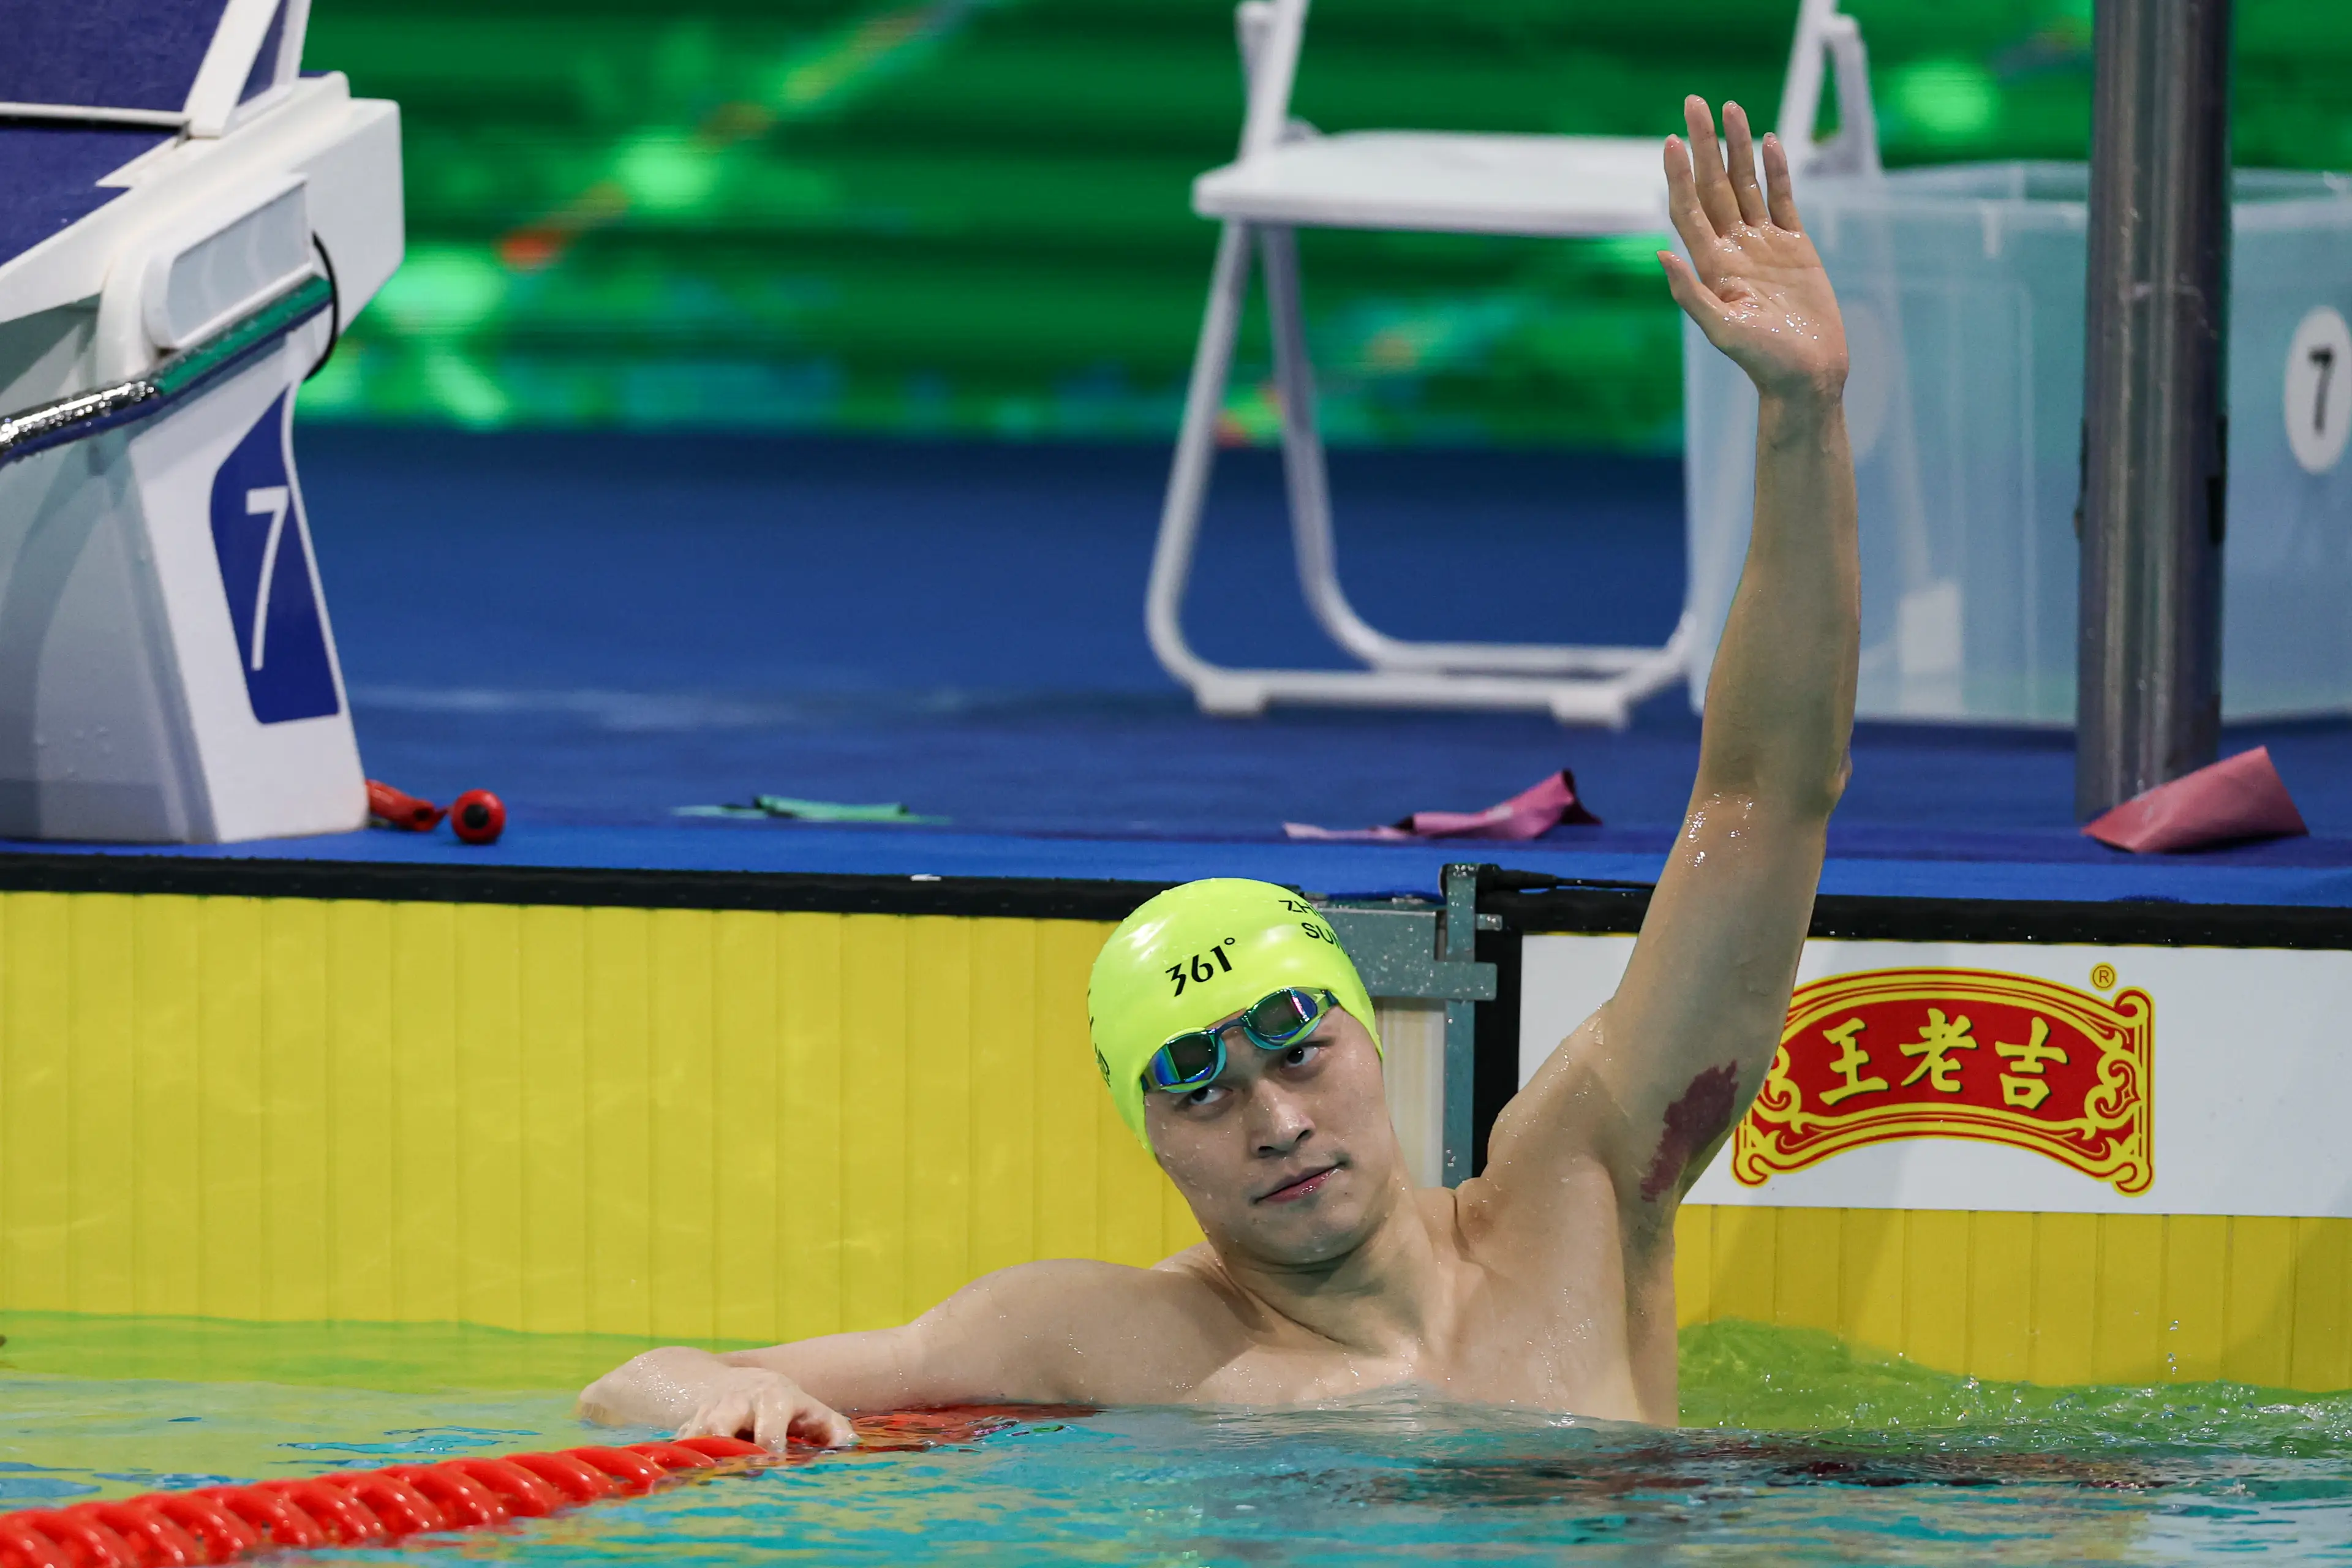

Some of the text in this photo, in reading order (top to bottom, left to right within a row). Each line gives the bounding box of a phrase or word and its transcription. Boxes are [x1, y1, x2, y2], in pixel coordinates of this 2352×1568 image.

[2308, 347, 2335, 436] 7
[246, 486, 289, 671] 7
[1819, 1008, 2069, 1110] 王老吉
